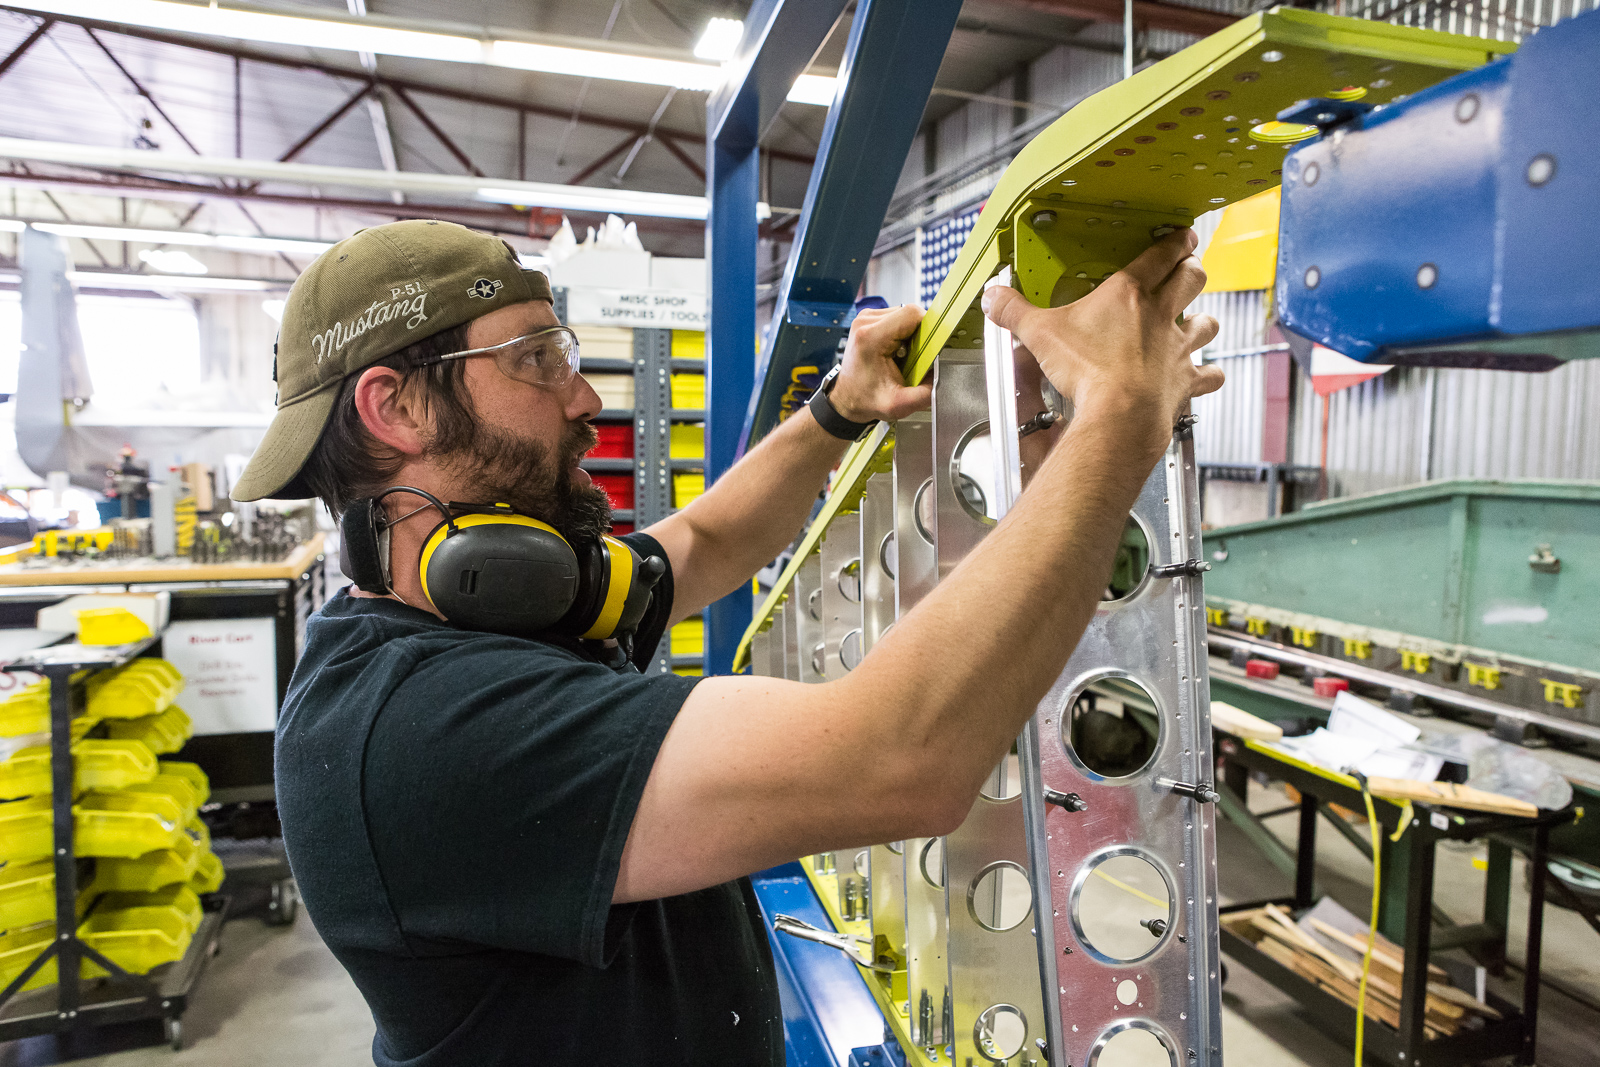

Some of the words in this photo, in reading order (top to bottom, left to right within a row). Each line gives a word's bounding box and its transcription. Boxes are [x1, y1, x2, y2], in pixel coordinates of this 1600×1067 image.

[391, 281, 424, 300] P-51
[619, 295, 647, 305] MISC
[655, 297, 687, 306] SHOP
[601, 307, 655, 319] SUPPLIES
[312, 293, 428, 364] Mustang
